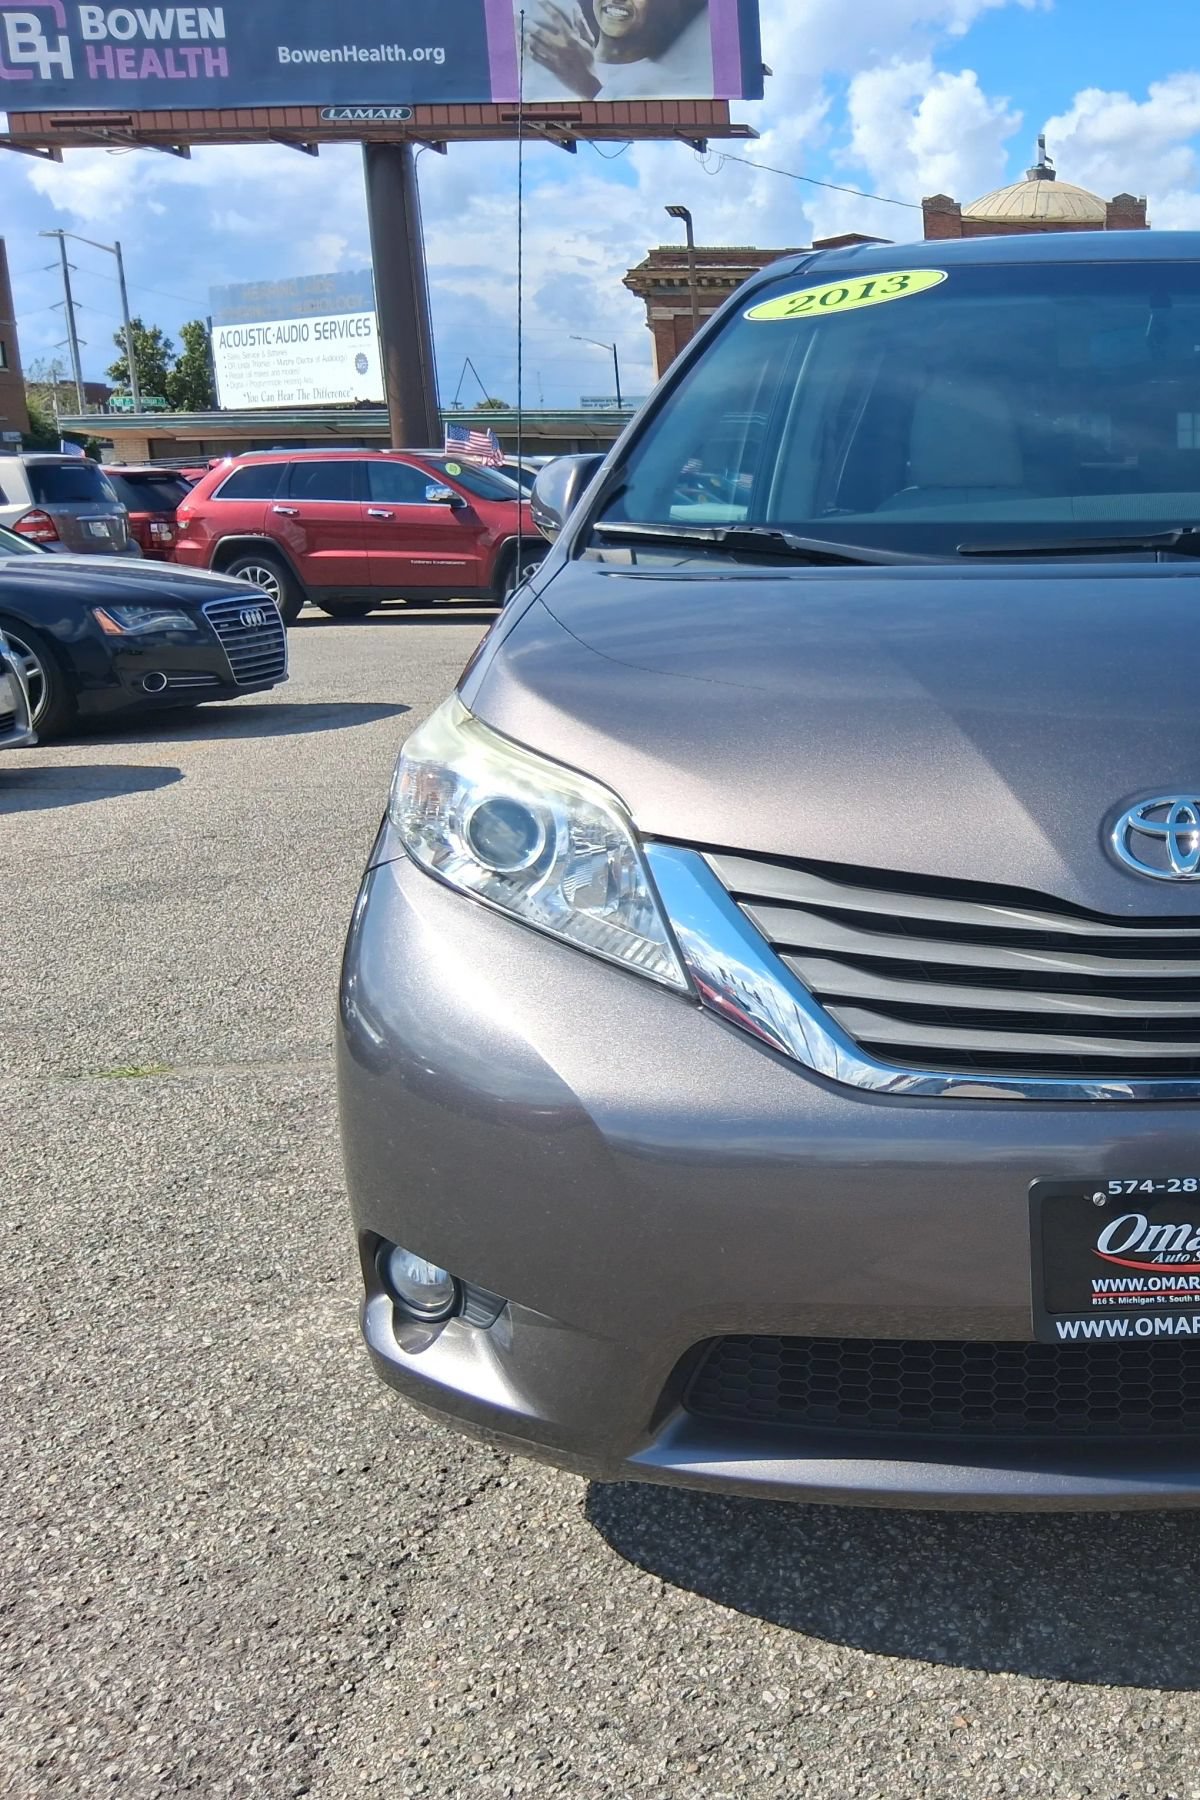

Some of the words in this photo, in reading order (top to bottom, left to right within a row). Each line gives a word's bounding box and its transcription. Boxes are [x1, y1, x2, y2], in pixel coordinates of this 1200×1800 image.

[78, 5, 226, 41] BOWEN
[85, 45, 229, 80] HEALTH
[277, 44, 446, 65] BowenHealth.org
[328, 108, 403, 119] LAMAR
[783, 274, 911, 315] 2013
[314, 317, 372, 341] SERVICES
[261, 390, 275, 402] Can
[277, 389, 294, 401] Hear
[296, 388, 311, 400] The
[1151, 1251, 1191, 1264] Auto
[1092, 1297, 1107, 1305] 816
[1118, 1295, 1155, 1306] Michigan
[1156, 1295, 1167, 1303] St.
[1169, 1294, 1193, 1303] South
